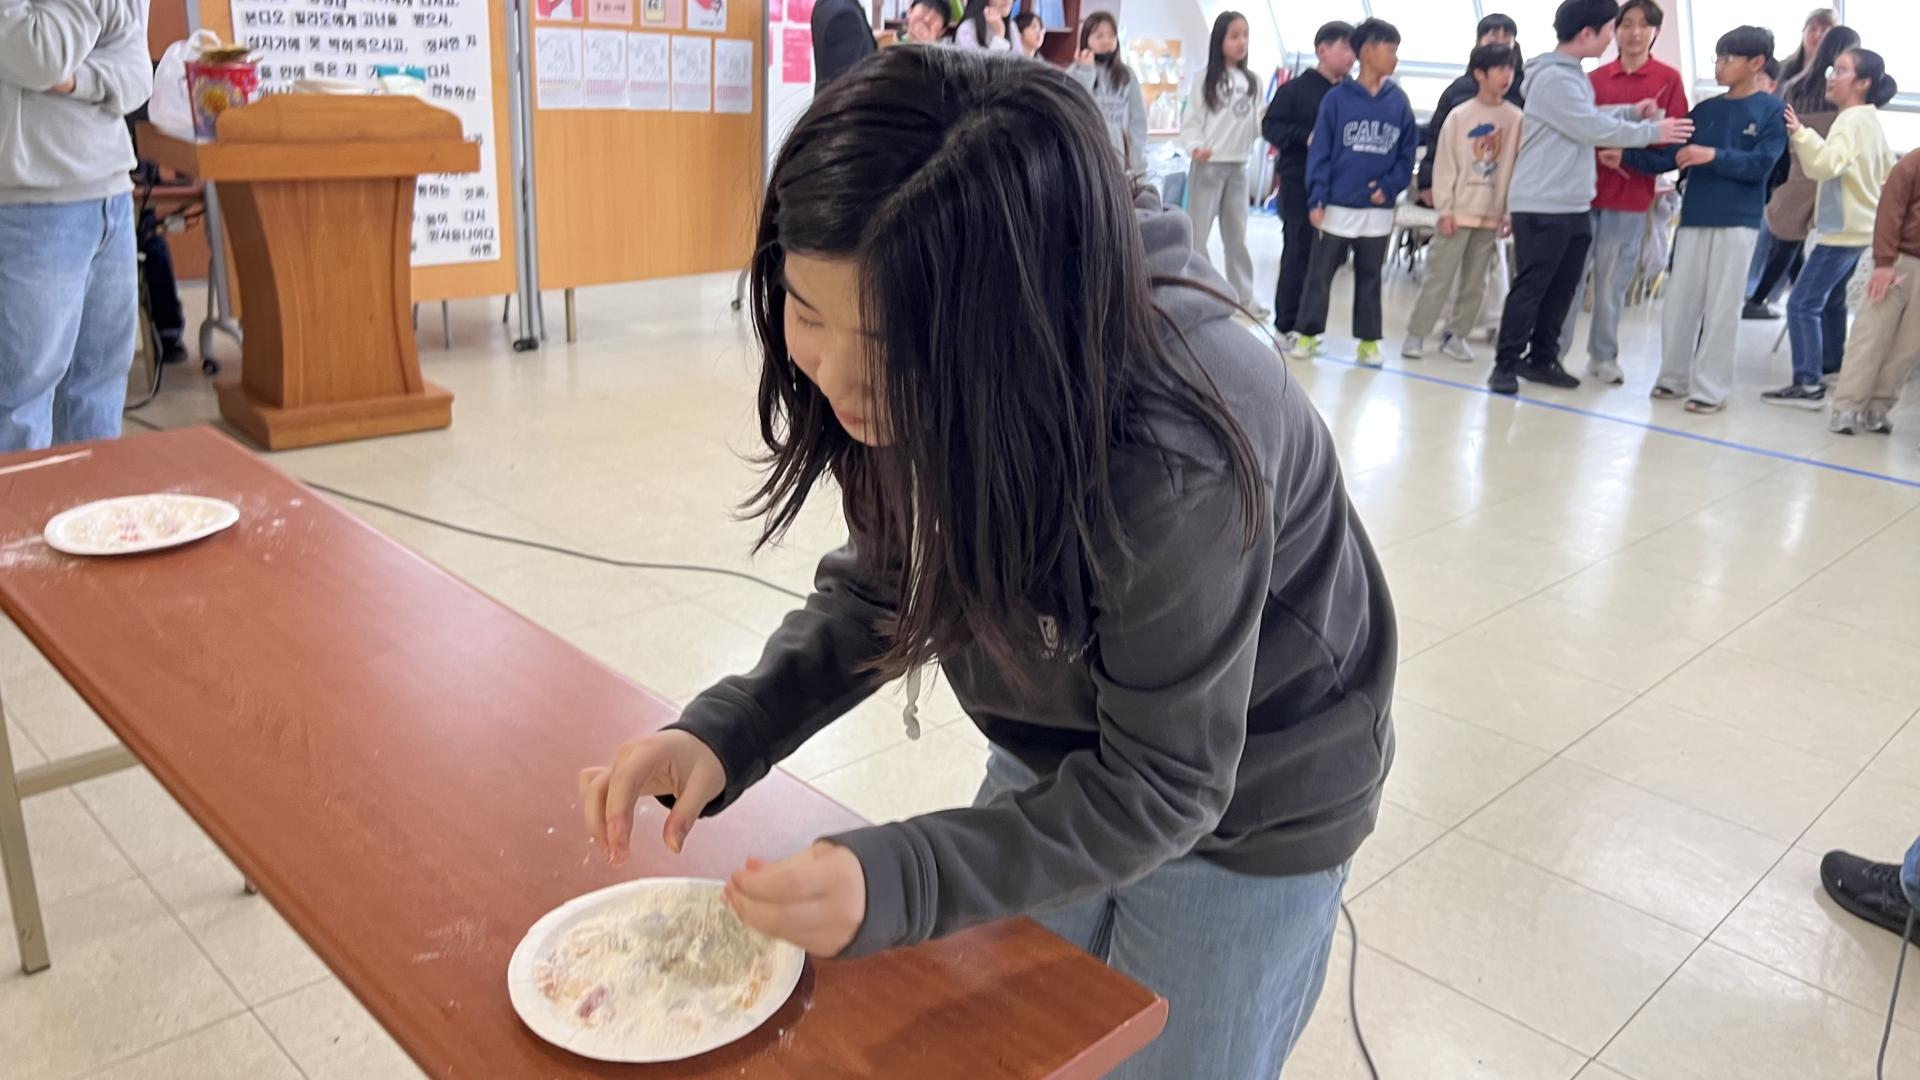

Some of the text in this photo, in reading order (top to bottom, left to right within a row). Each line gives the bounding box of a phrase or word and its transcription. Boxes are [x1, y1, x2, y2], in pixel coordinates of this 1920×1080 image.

[244, 10, 286, 26] 본디오
[294, 10, 357, 27] 빌라도에게
[363, 11, 398, 27] 고난을
[248, 35, 301, 51] 십자가에
[309, 35, 321, 51] 못
